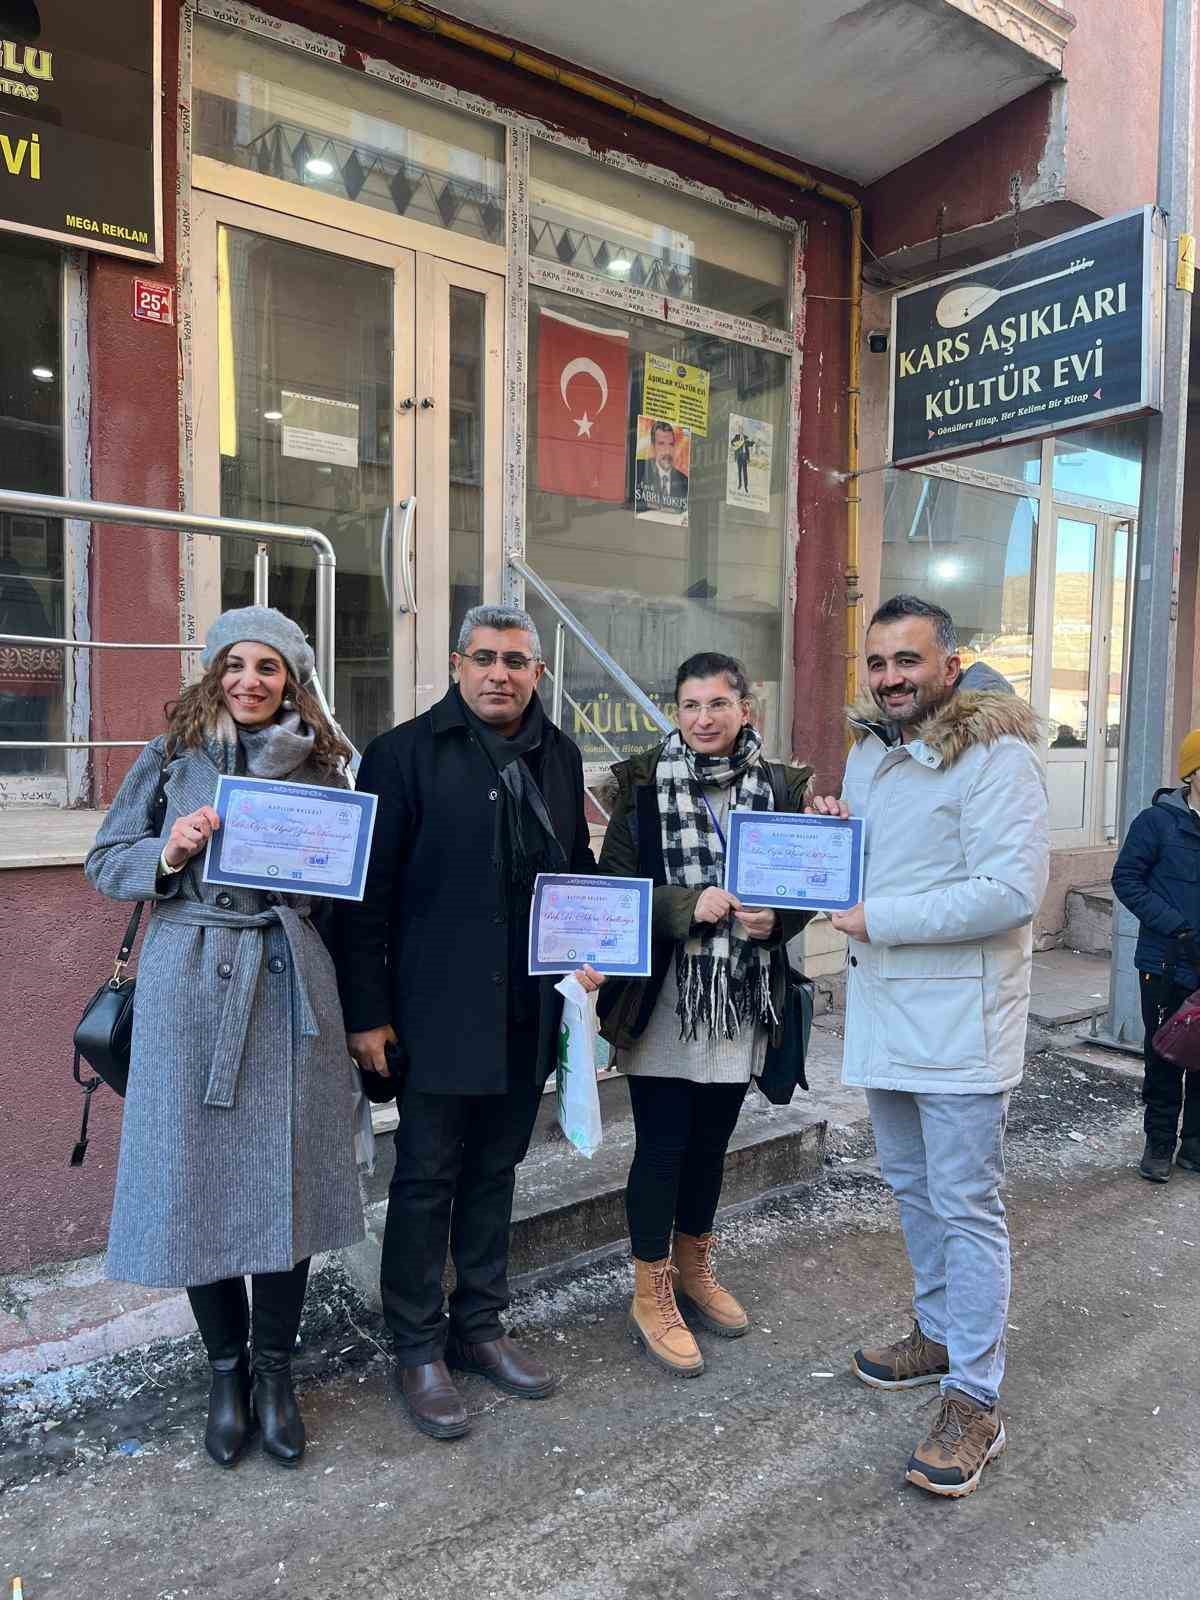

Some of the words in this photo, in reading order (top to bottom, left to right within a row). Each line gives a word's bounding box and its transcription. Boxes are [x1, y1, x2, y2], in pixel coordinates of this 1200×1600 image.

[0, 40, 53, 80] LU
[66, 214, 99, 233] MEGA
[102, 223, 149, 244] REKLAM
[184, 313, 192, 340] AKPA
[900, 332, 969, 378] KARS
[979, 282, 1127, 356] AŞIKLARI
[926, 364, 1042, 421] KÜLTÜR
[1054, 338, 1103, 388] EVİ
[937, 418, 973, 436] Gönüllere
[1001, 409, 1015, 421] Her
[1018, 404, 1046, 416] Kelime
[1048, 399, 1061, 409] Bir
[187, 615, 195, 641] AKPA
